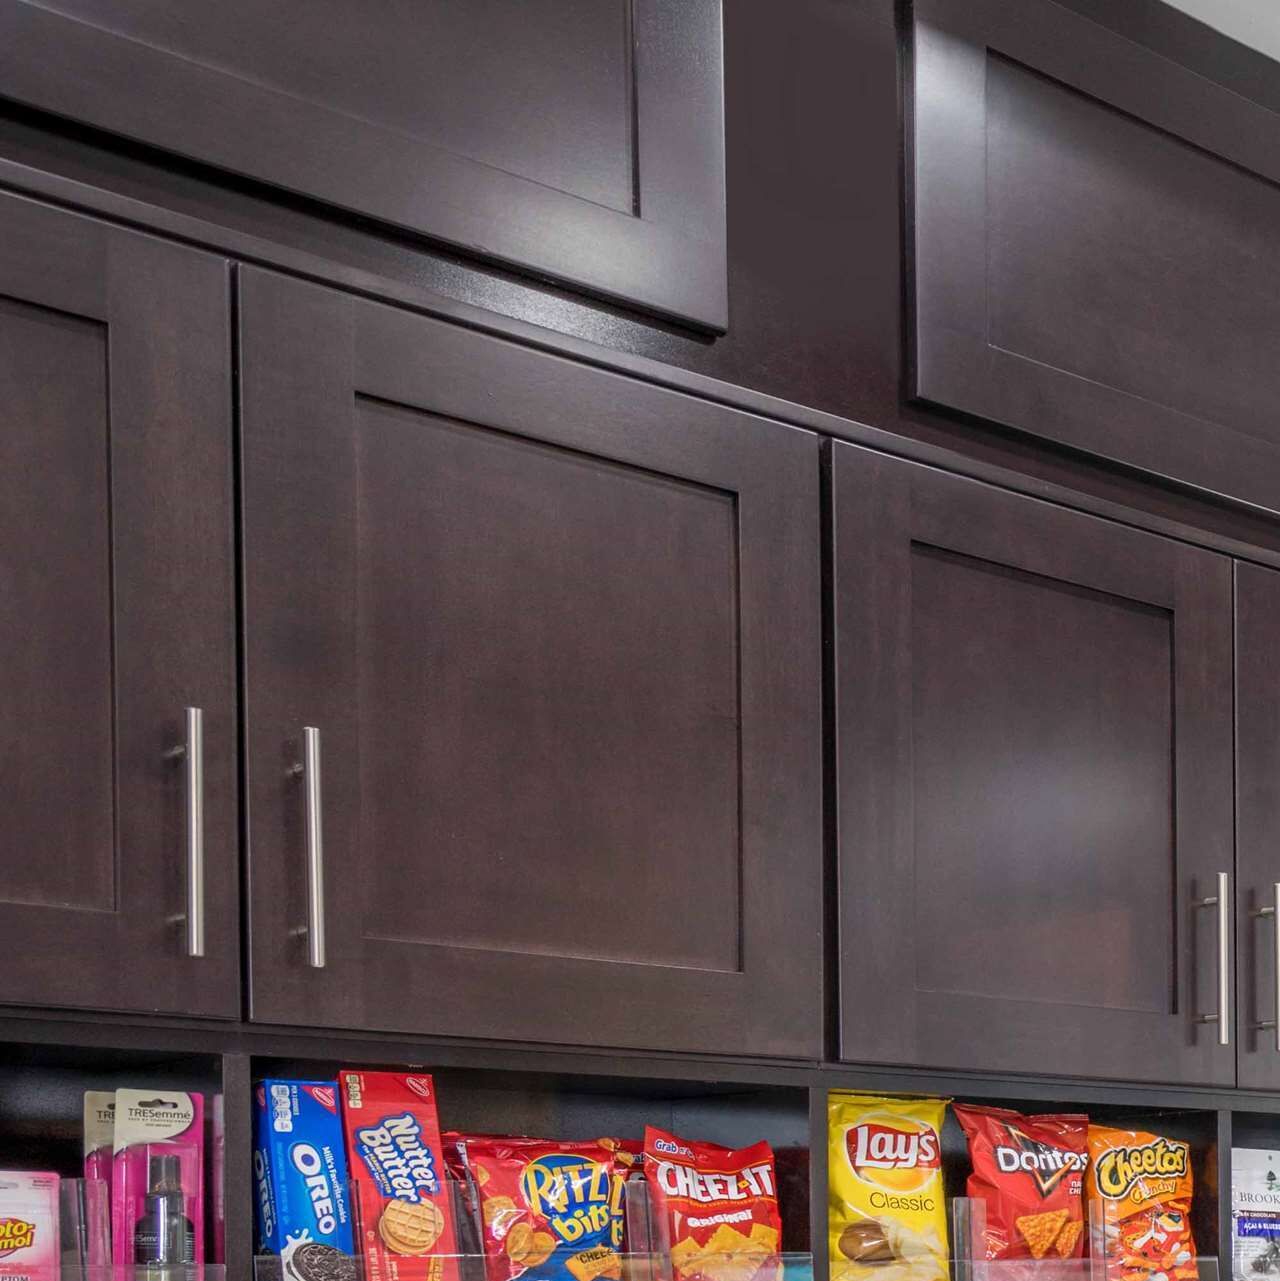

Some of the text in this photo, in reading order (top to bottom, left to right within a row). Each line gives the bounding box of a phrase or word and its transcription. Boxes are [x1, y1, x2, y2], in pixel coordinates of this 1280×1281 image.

[128, 1108, 191, 1120] TRESemmé
[360, 1128, 418, 1203] Butter
[385, 1115, 437, 1193] Nutter
[656, 1139, 678, 1153] Grab
[855, 1124, 937, 1168] Lay's
[996, 1146, 1088, 1174] Doritos
[293, 1142, 337, 1234] OREO
[523, 1163, 607, 1214] RITZ
[1097, 1140, 1188, 1198] Cheetos
[870, 1191, 935, 1212] Classic
[1130, 1179, 1176, 1204] Crunchy
[552, 1204, 612, 1242] bits
